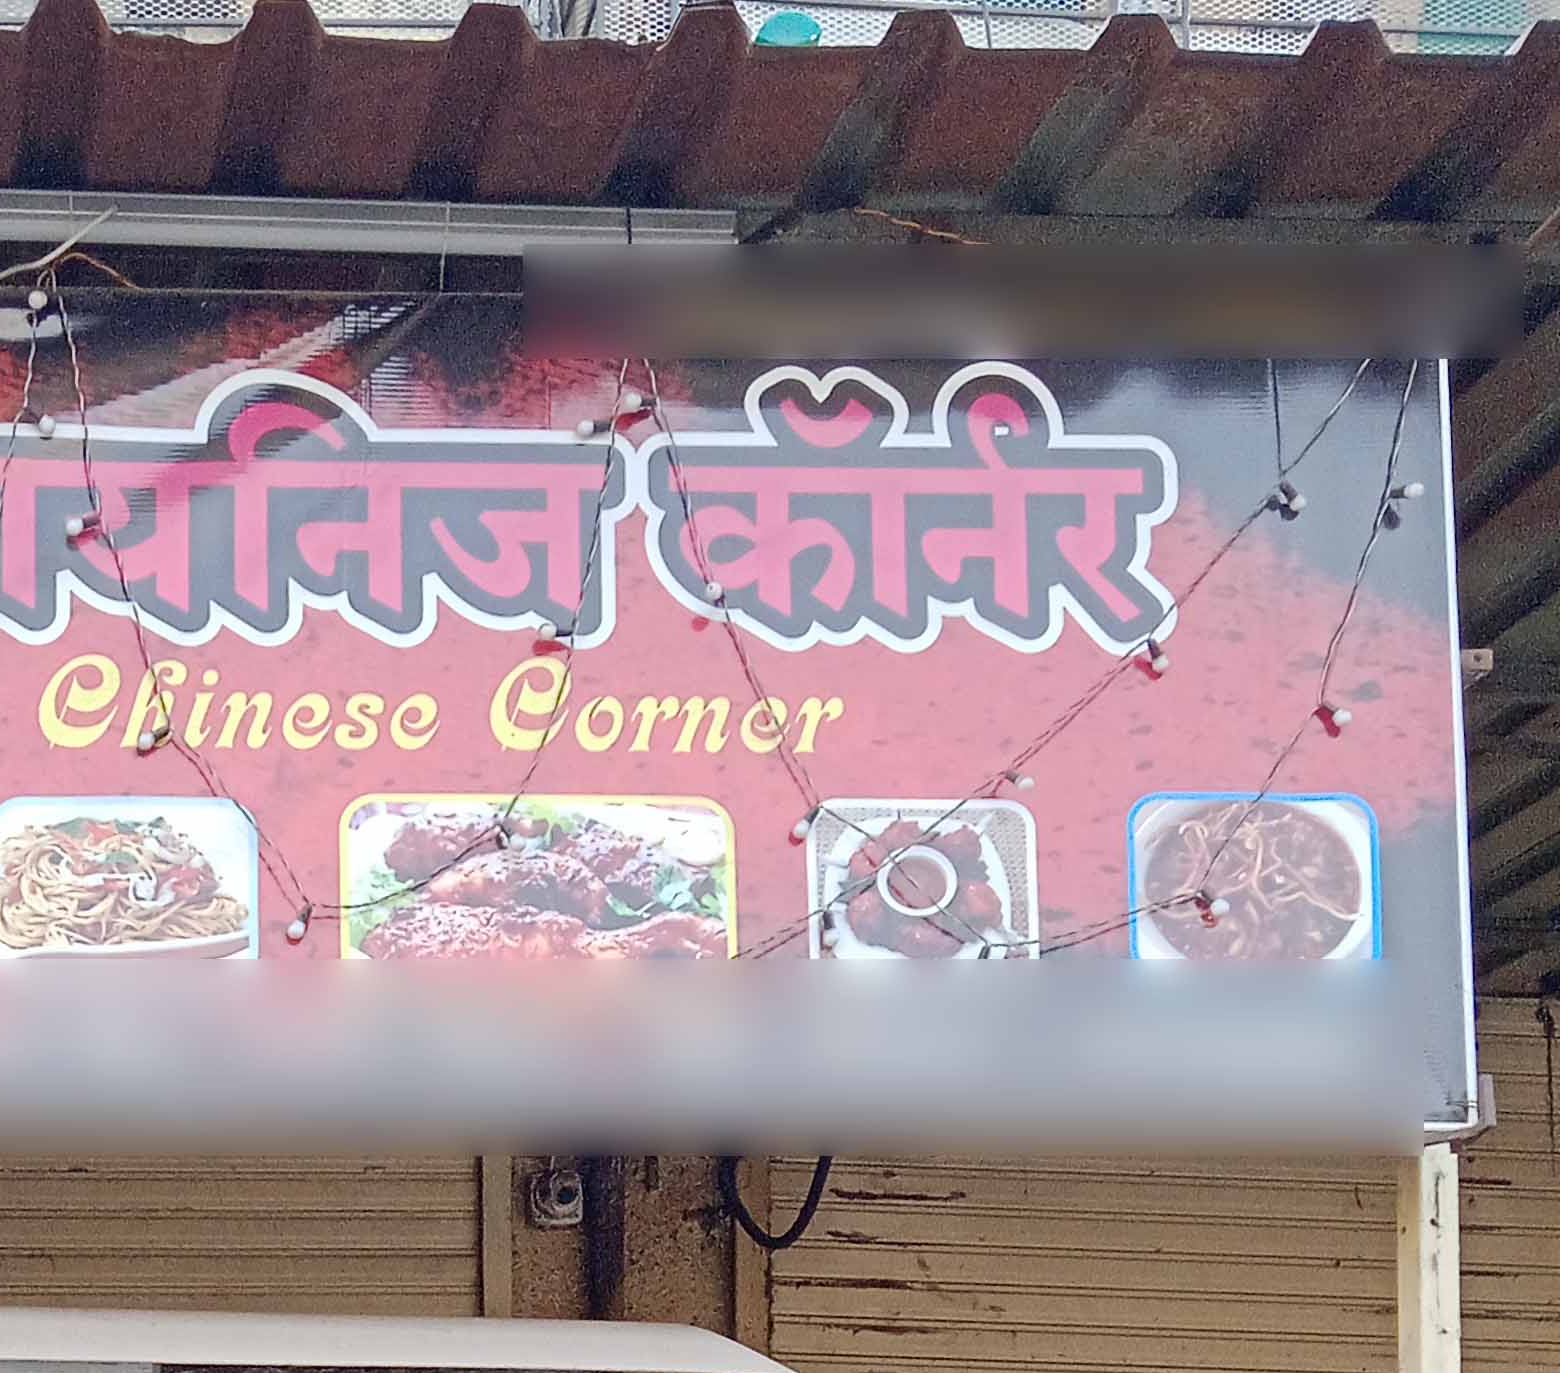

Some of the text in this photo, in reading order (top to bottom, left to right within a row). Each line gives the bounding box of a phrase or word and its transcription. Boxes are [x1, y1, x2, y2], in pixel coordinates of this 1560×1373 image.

[669, 393, 1143, 622] कॉर्नर
[38, 653, 440, 751] Chinese
[488, 656, 845, 754] Corner
